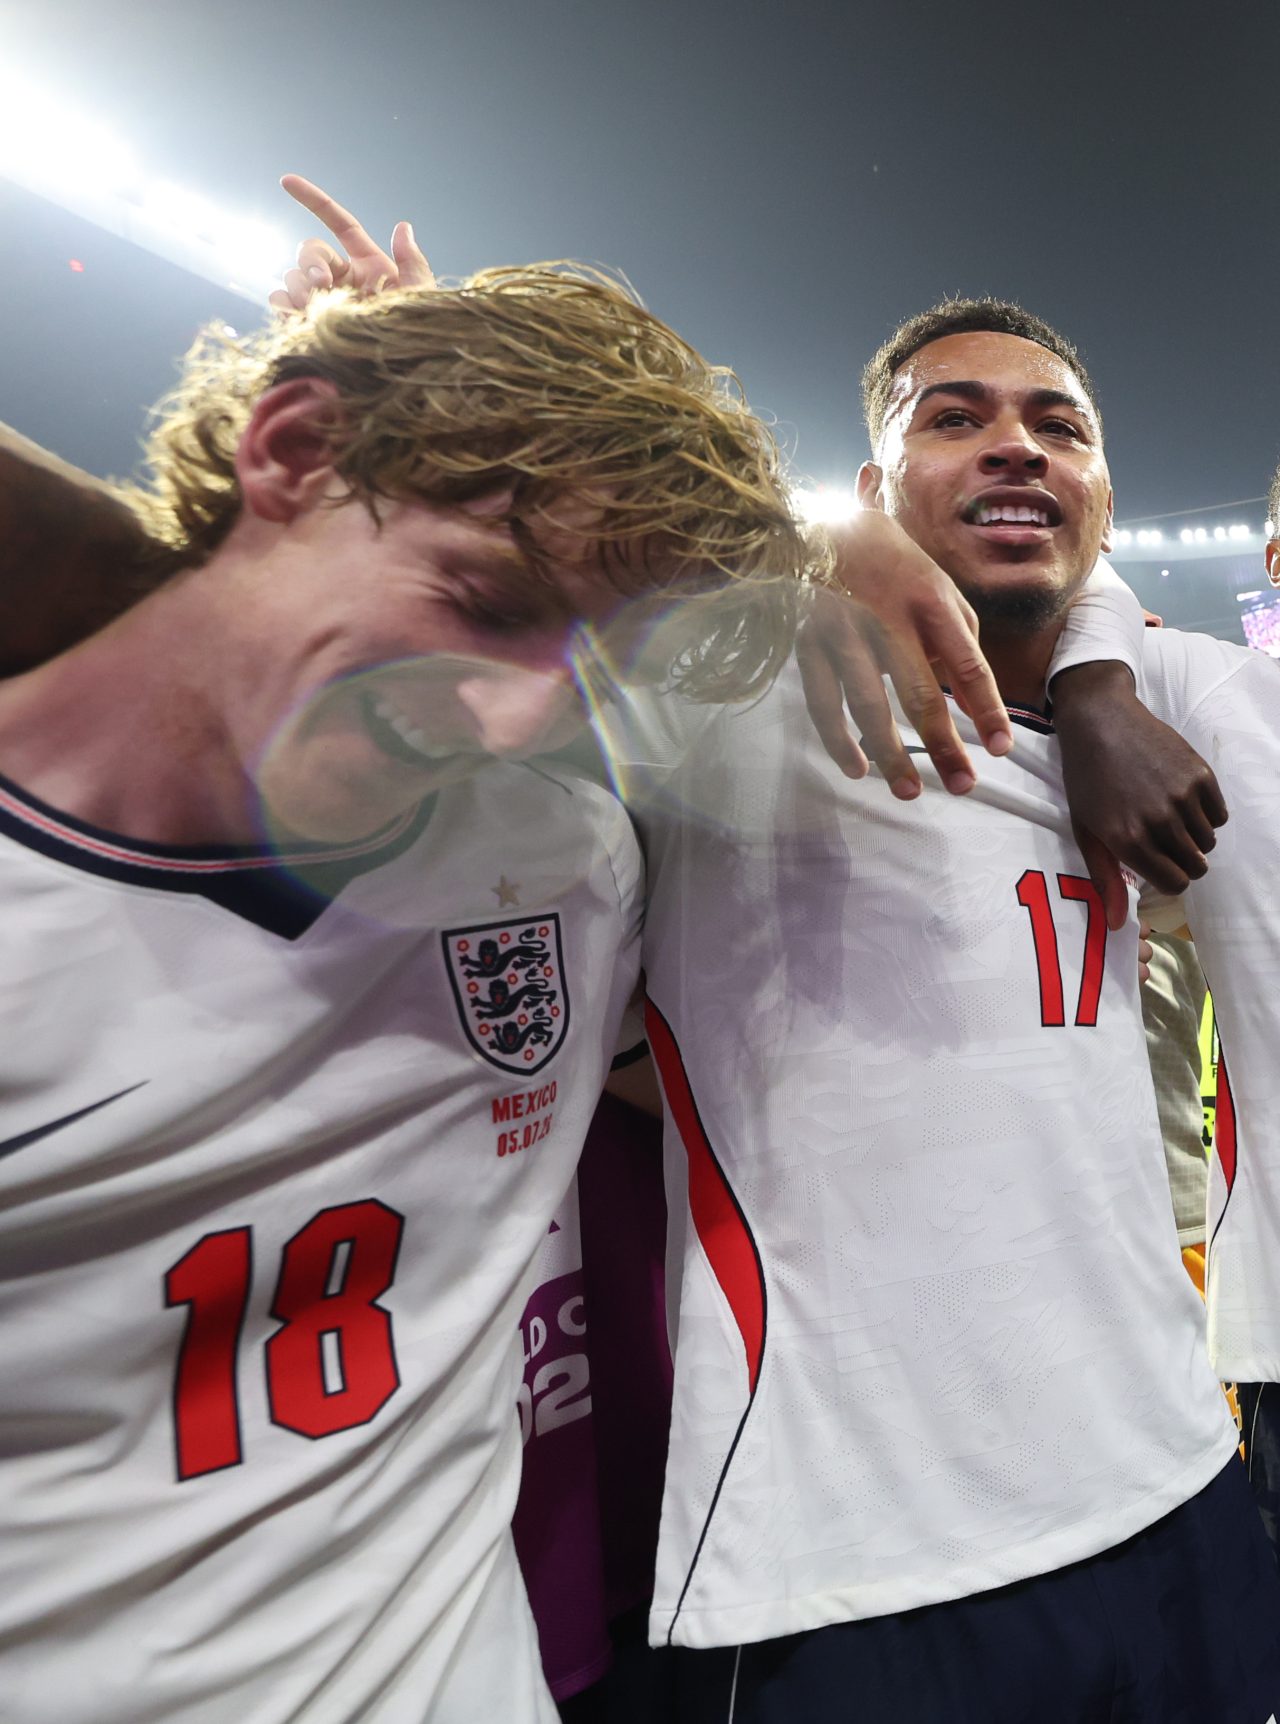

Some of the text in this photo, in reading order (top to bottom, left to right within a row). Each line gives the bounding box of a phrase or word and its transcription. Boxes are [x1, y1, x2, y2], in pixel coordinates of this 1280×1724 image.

[1015, 868, 1108, 1027] 17
[491, 1080, 557, 1124] MEXICO
[163, 1198, 405, 1482] 18
